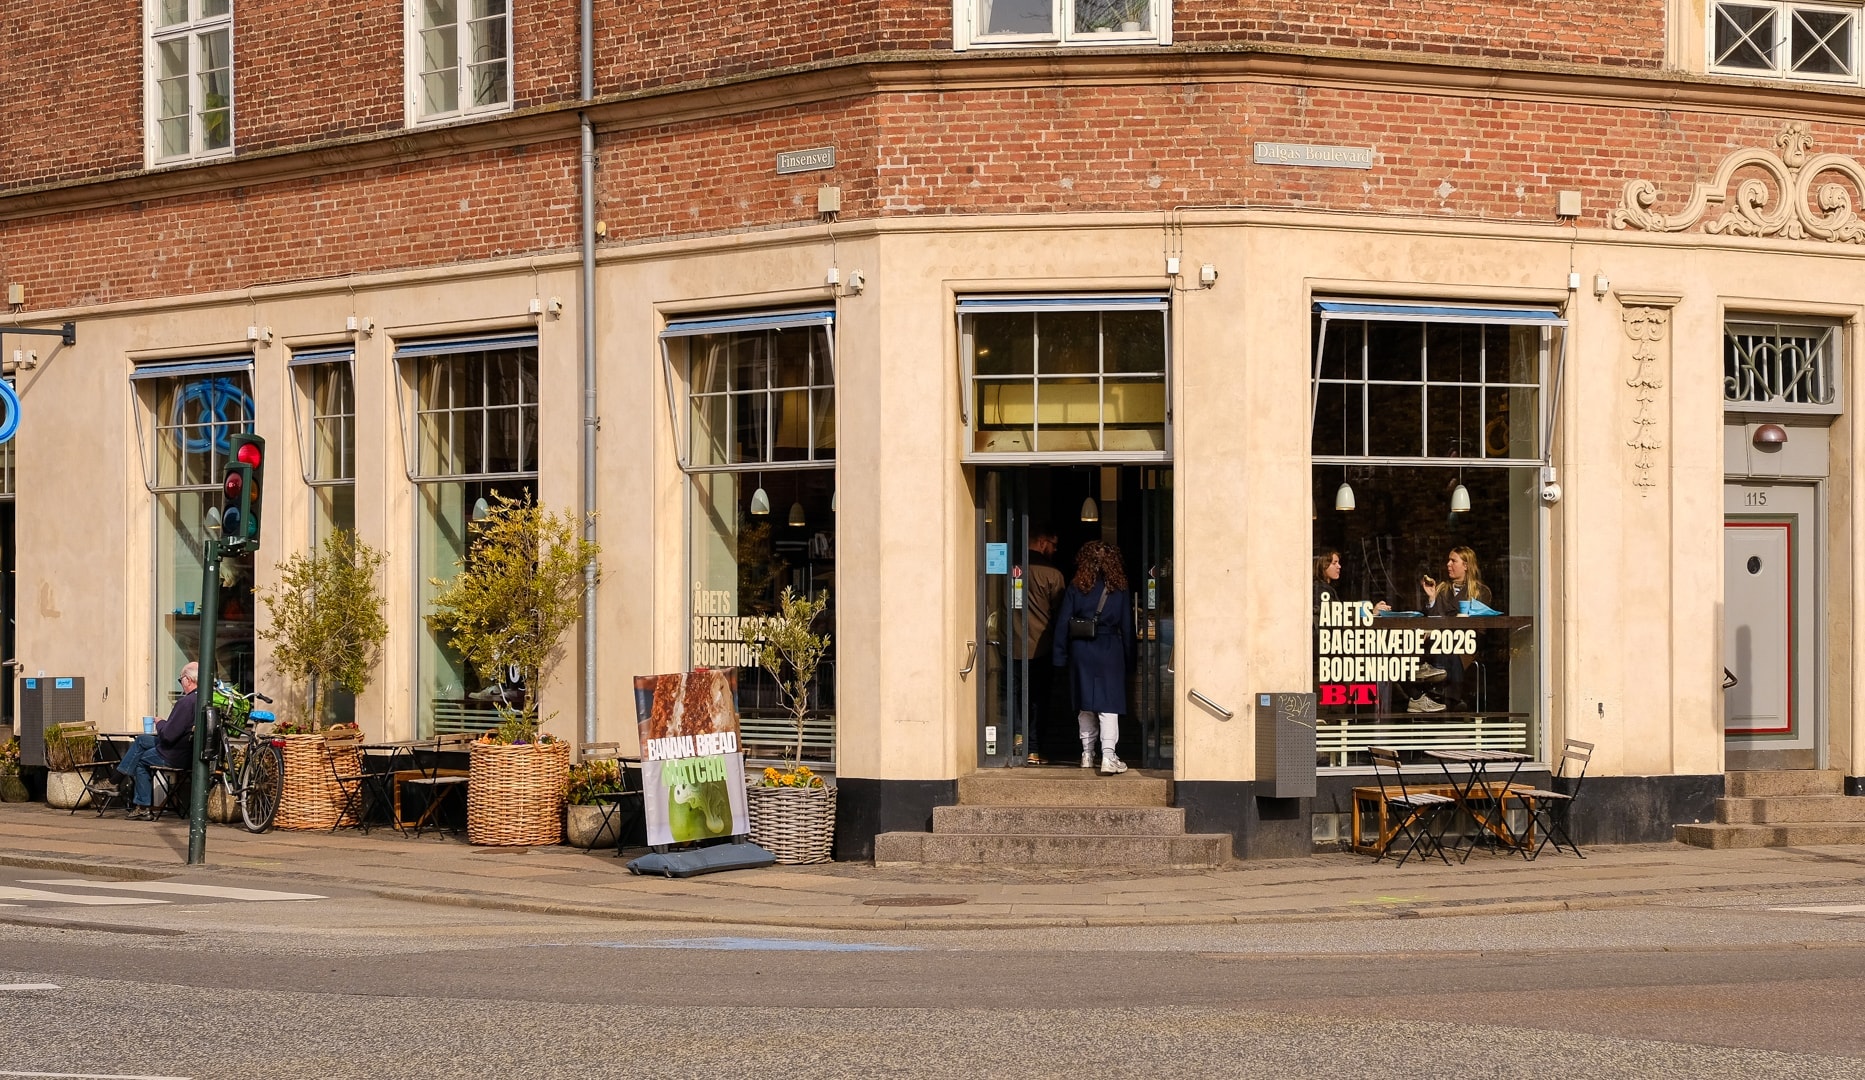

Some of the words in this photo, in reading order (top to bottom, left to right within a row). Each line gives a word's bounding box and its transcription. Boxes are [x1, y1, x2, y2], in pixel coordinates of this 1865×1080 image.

[780, 150, 831, 168] Finsensvej
[1257, 144, 1301, 162] Dalgas
[1305, 147, 1370, 163] Boulevard
[1746, 492, 1767, 506] 115
[693, 580, 731, 615] ÅRETS
[1319, 592, 1374, 627] ÅRETS
[1319, 629, 1425, 655] BAGERKÆDE
[1430, 629, 1477, 655] 2026
[1319, 656, 1421, 682] BODENHOFF
[647, 735, 695, 761] BANANA
[696, 731, 738, 756] BREAD
[661, 755, 728, 786] MATCHA
